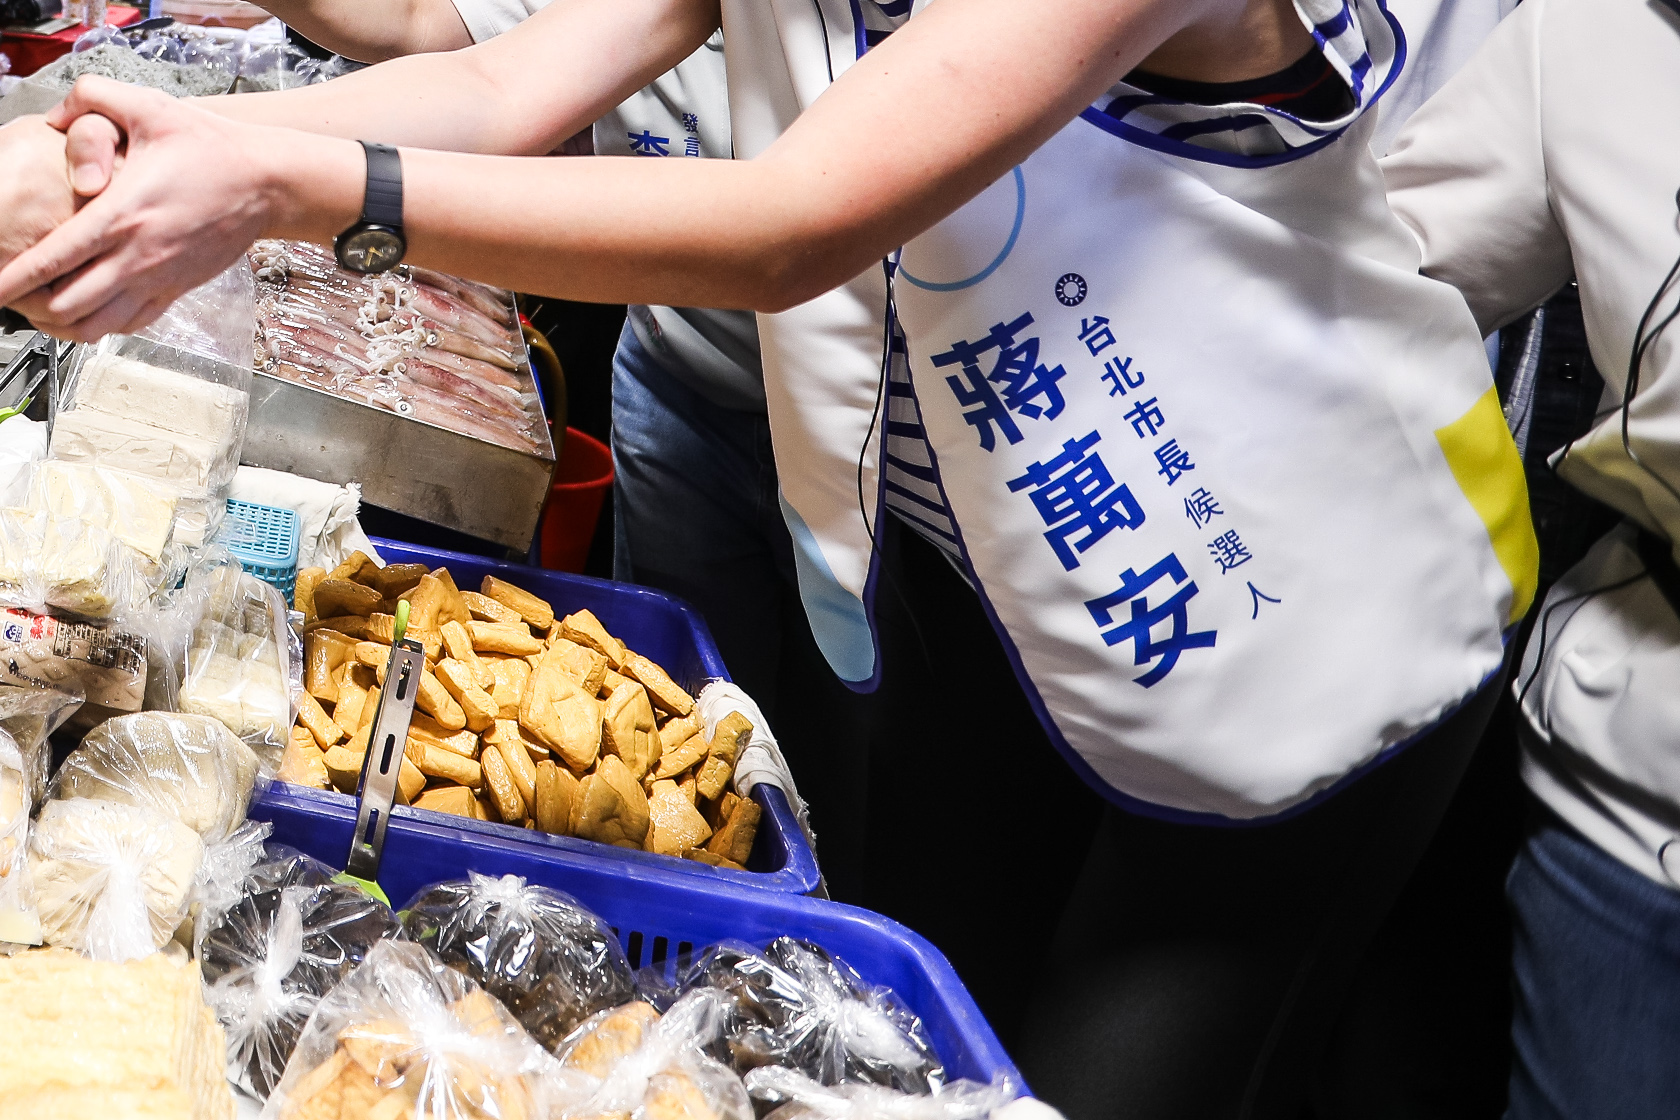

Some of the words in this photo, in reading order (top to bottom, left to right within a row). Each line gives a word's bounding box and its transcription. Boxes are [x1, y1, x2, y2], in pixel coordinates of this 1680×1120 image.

[930, 311, 1218, 689] 蔣萬安
[1077, 315, 1281, 620] 台北市長候選人
